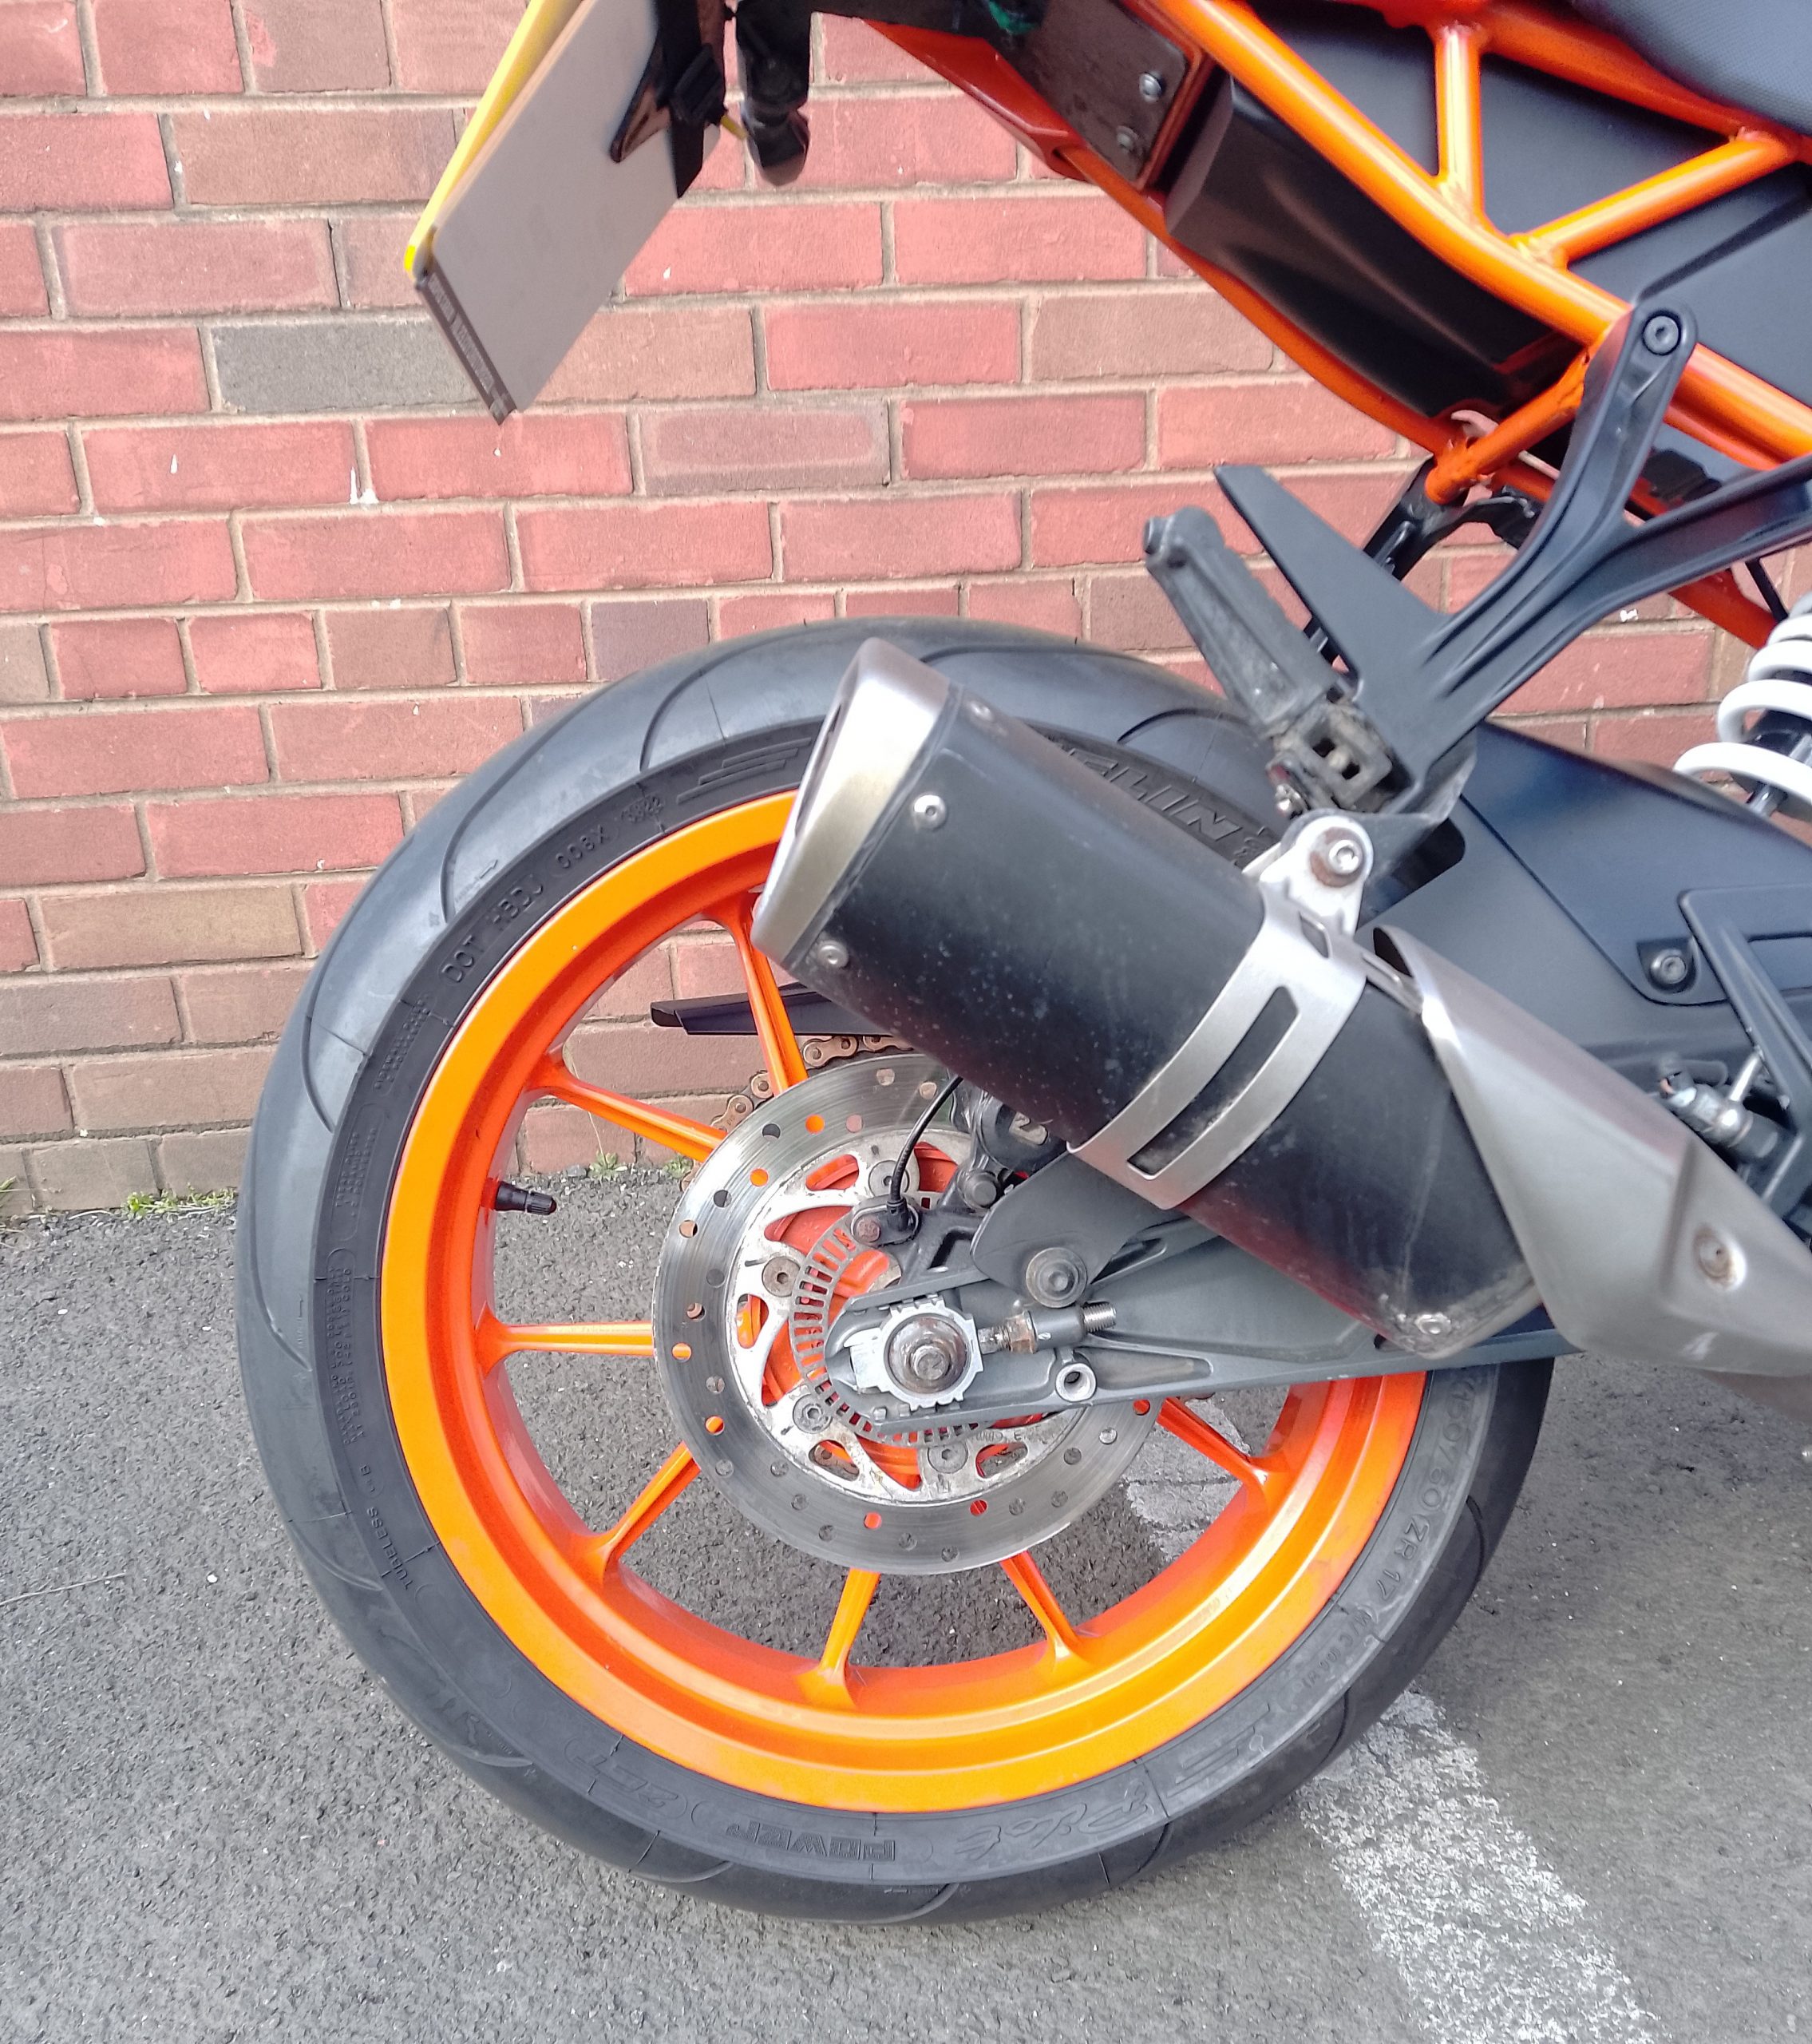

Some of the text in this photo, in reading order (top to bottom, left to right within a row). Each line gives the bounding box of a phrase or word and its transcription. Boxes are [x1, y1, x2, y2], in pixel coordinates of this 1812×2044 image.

[440, 933, 485, 981] DOT
[366, 1505, 413, 1590] TUBELESS
[1393, 1518, 1429, 1562] ZR
[1371, 1567, 1403, 1602] 17
[725, 1820, 894, 1861] POWER
[954, 1781, 1150, 1861] Pilot
